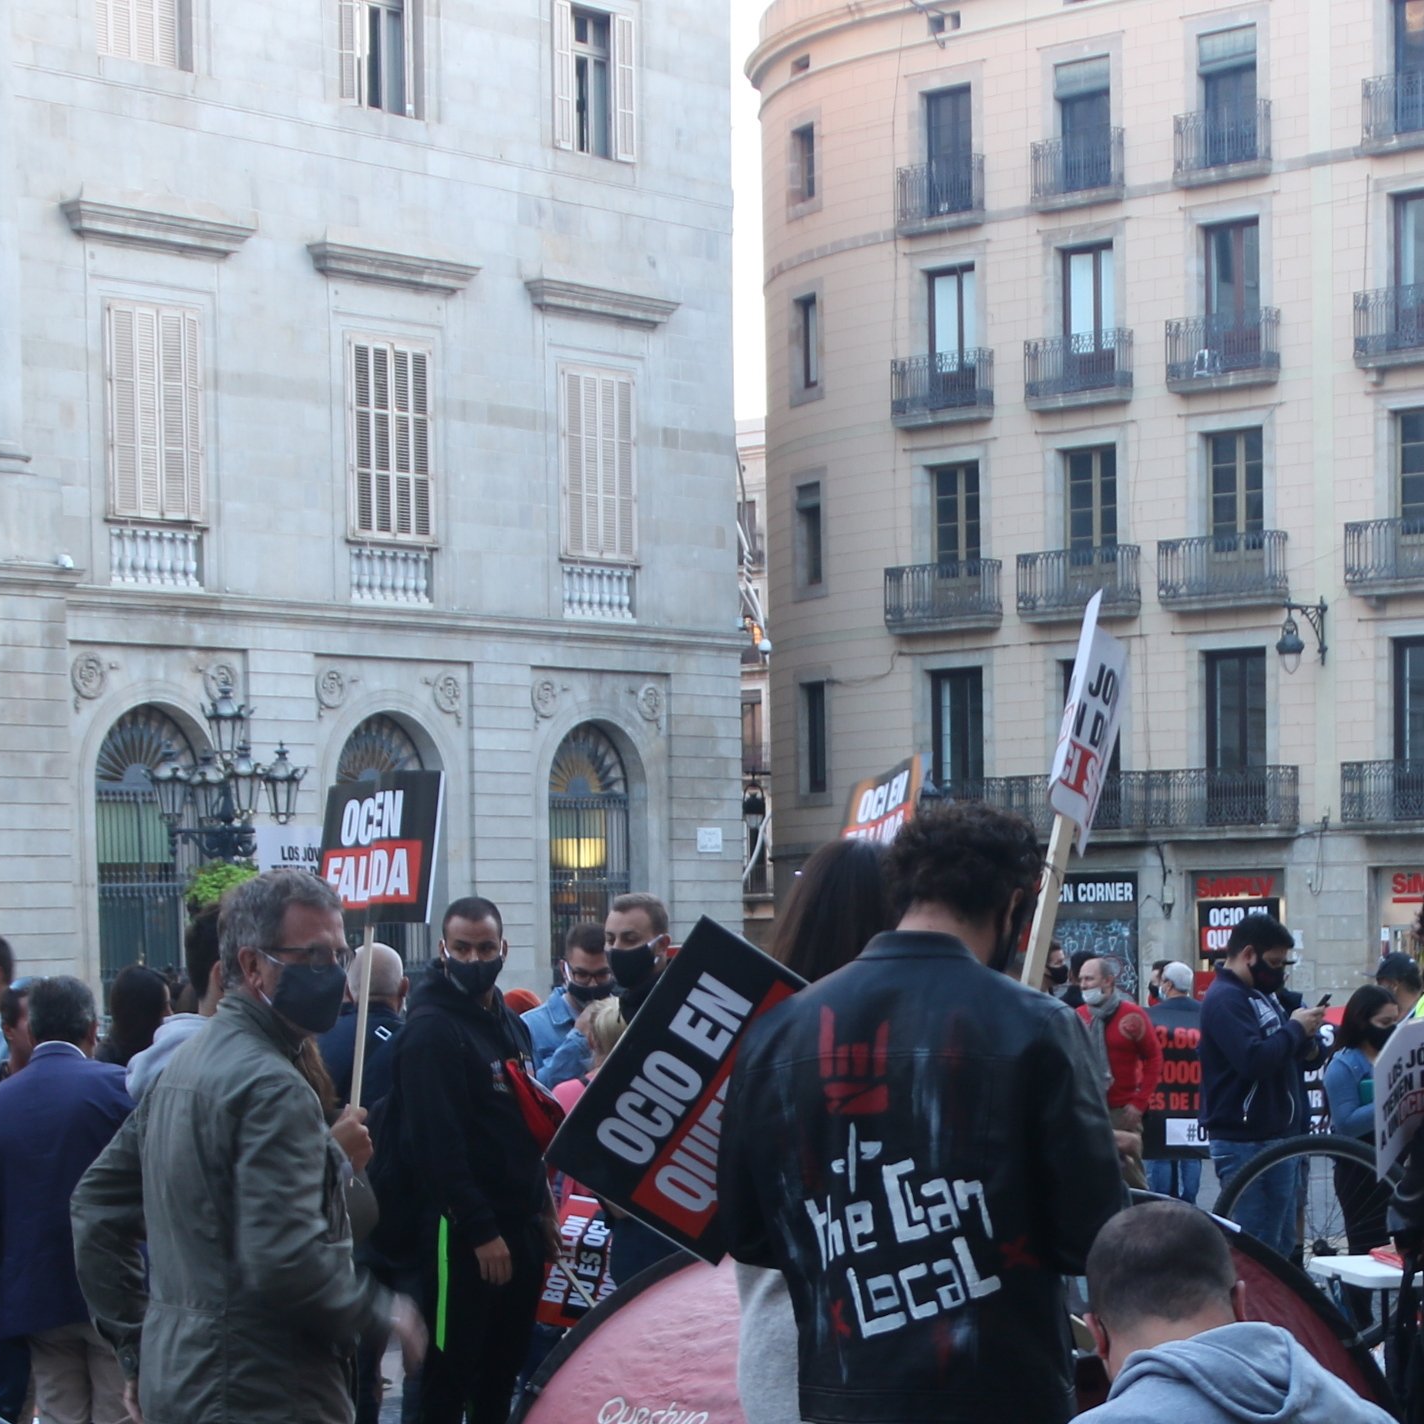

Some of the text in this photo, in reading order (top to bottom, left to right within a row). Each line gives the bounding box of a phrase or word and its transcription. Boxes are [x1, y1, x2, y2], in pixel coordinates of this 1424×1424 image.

[281, 843, 322, 862] LOS JÓV
[1078, 882, 1133, 902] CORNER
[1209, 906, 1245, 927] OCIO
[596, 971, 754, 1165] OCIO EN
[1170, 1092, 1190, 1111] DE
